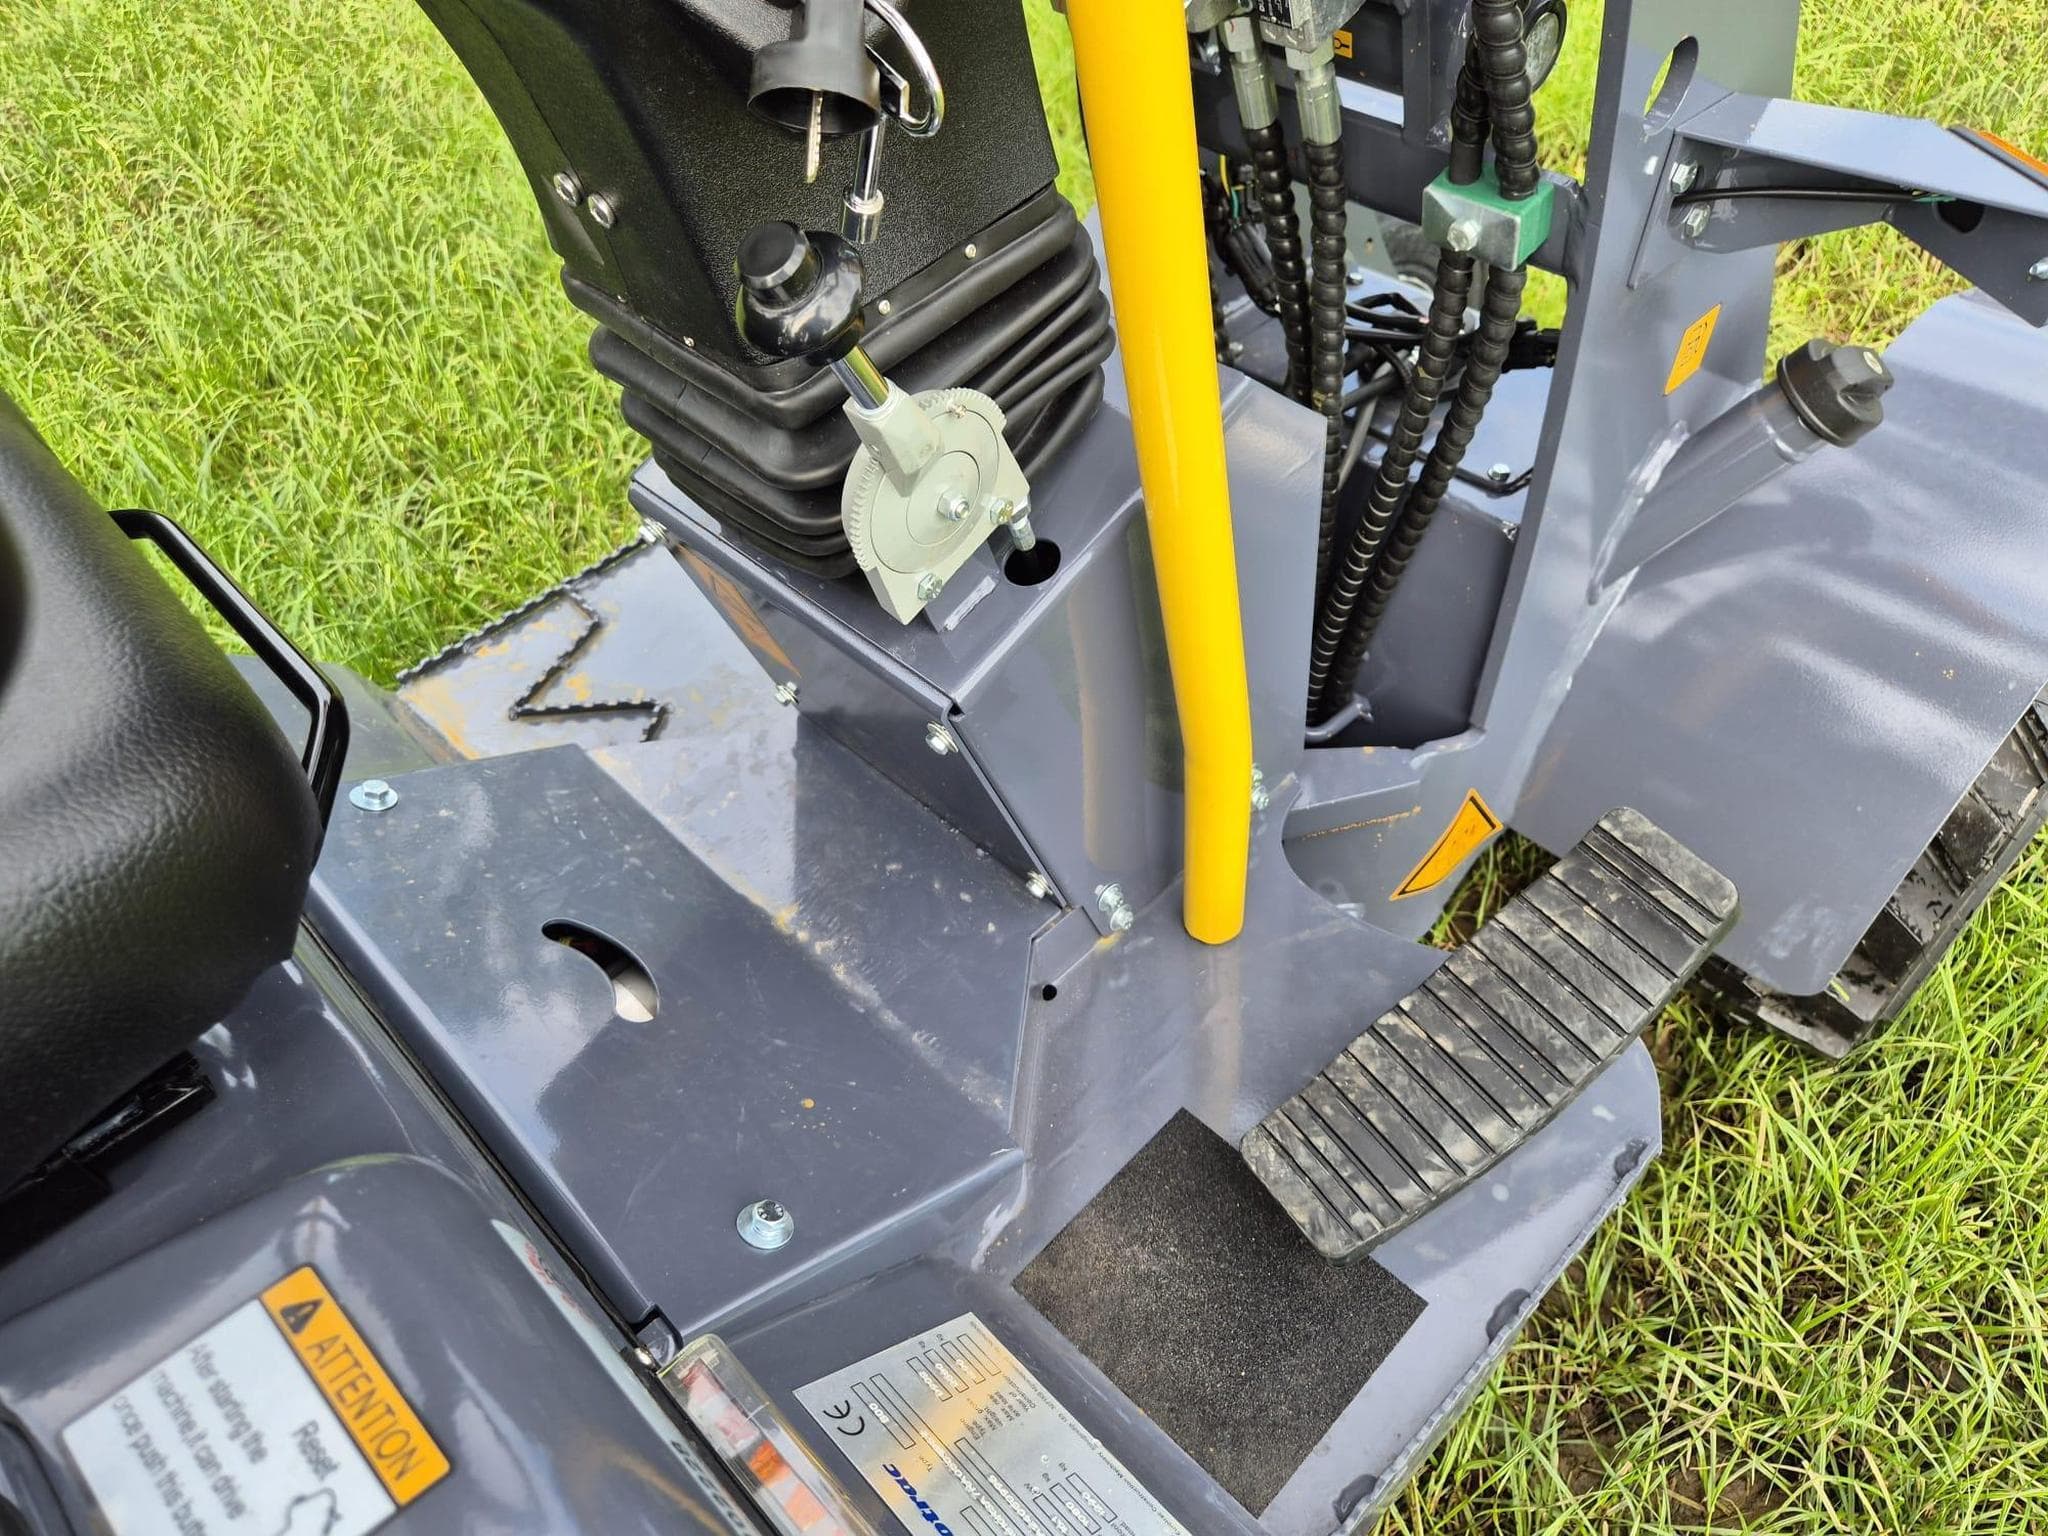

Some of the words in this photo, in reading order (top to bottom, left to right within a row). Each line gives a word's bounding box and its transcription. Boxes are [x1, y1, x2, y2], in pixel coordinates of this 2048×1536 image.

[109, 1393, 144, 1438] once
[128, 1431, 170, 1477] push
[155, 1470, 188, 1507] this
[185, 1340, 220, 1383] After
[206, 1376, 252, 1441] starting
[238, 1431, 271, 1465] the
[291, 1418, 342, 1481] Reset
[305, 1331, 426, 1483] ATTENTION
[823, 1400, 865, 1436] CE
[193, 1442, 224, 1479] can
[209, 1470, 249, 1522] drive
